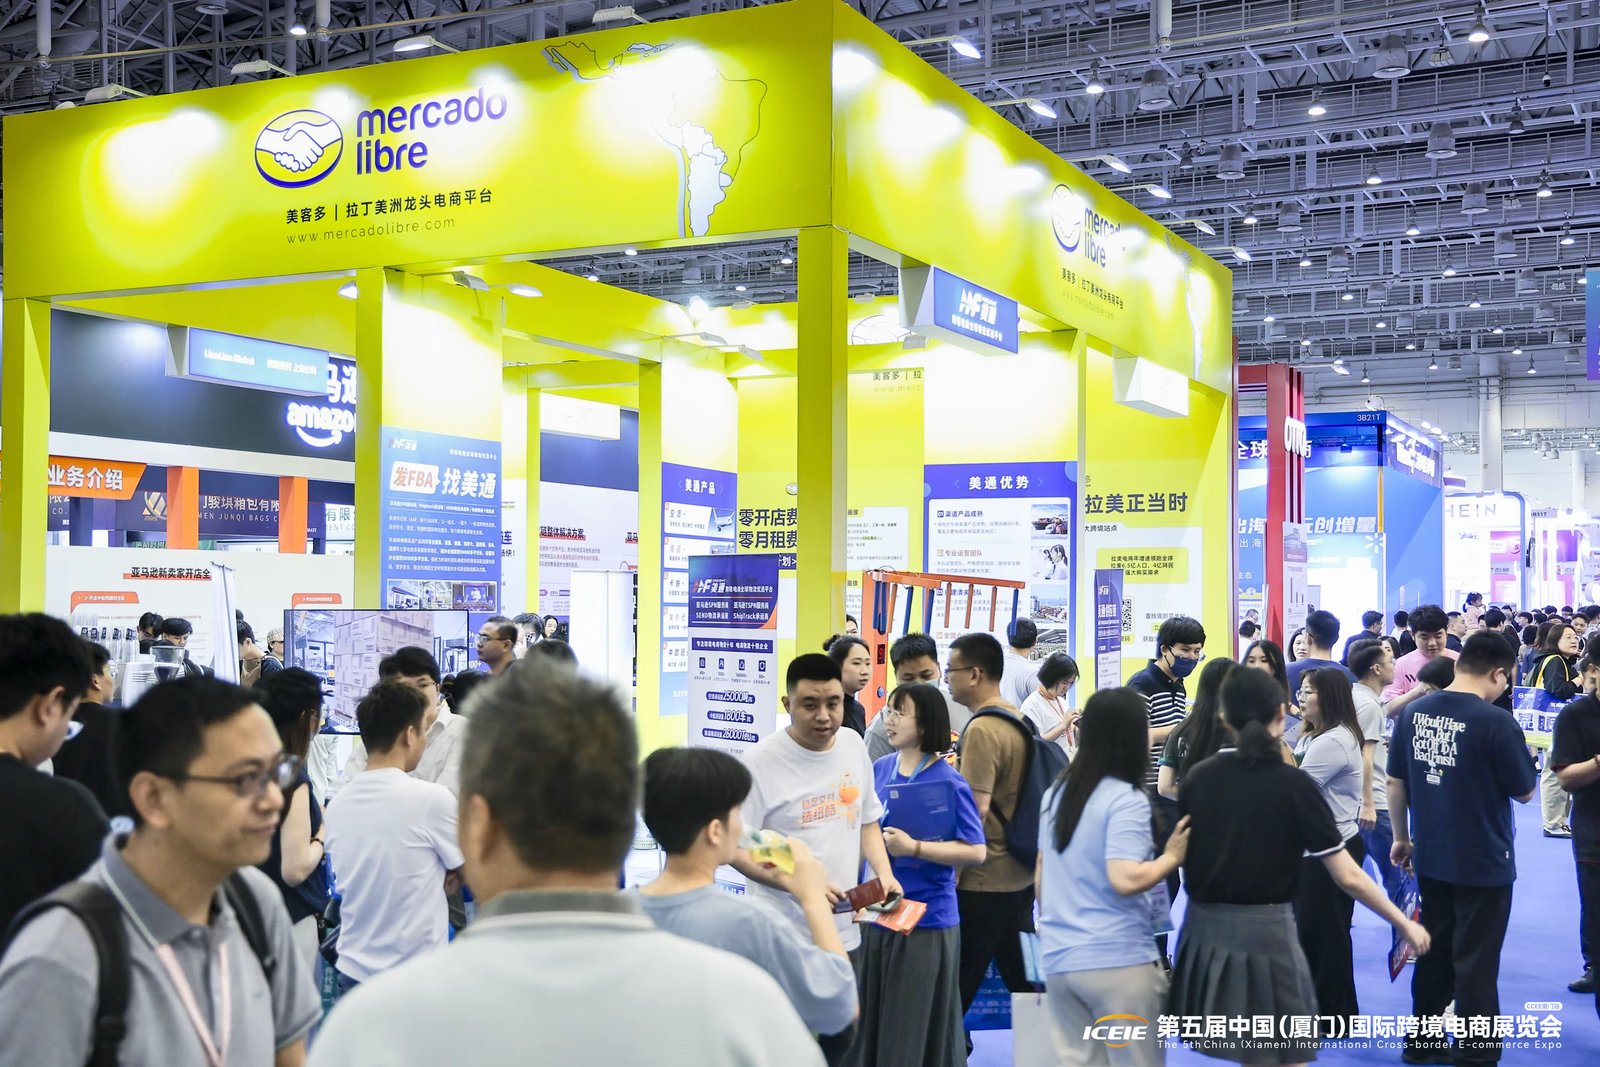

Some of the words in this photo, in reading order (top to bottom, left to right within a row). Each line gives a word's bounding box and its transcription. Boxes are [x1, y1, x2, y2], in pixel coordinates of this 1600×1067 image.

[356, 86, 508, 138] mercado
[356, 140, 429, 176] libre
[286, 205, 327, 225] 美客多
[346, 187, 493, 218] 拉丁美洲龙头电商平台
[286, 217, 455, 244] www.mercadolibre.com
[1084, 230, 1107, 268] libre
[287, 402, 357, 433] amazo
[48, 464, 124, 491] 业务介绍
[393, 466, 434, 488] 发FBA
[441, 467, 497, 499] 找美通
[684, 478, 716, 495] 美通产品
[968, 475, 1030, 491] 美通优势
[1085, 491, 1188, 514] 拉美正当时
[219, 513, 246, 521] JUNQI
[249, 514, 270, 522] BAGS
[945, 549, 983, 557] 专业运营团队
[1418, 713, 1444, 729] Would
[1444, 717, 1466, 732] Have
[1412, 736, 1427, 750] Got
[1427, 738, 1440, 755] Off
[1440, 740, 1450, 755] To
[1450, 742, 1458, 755] A
[1436, 728, 1451, 742] But
[1414, 747, 1431, 762] Bad
[1431, 751, 1456, 767] Finish
